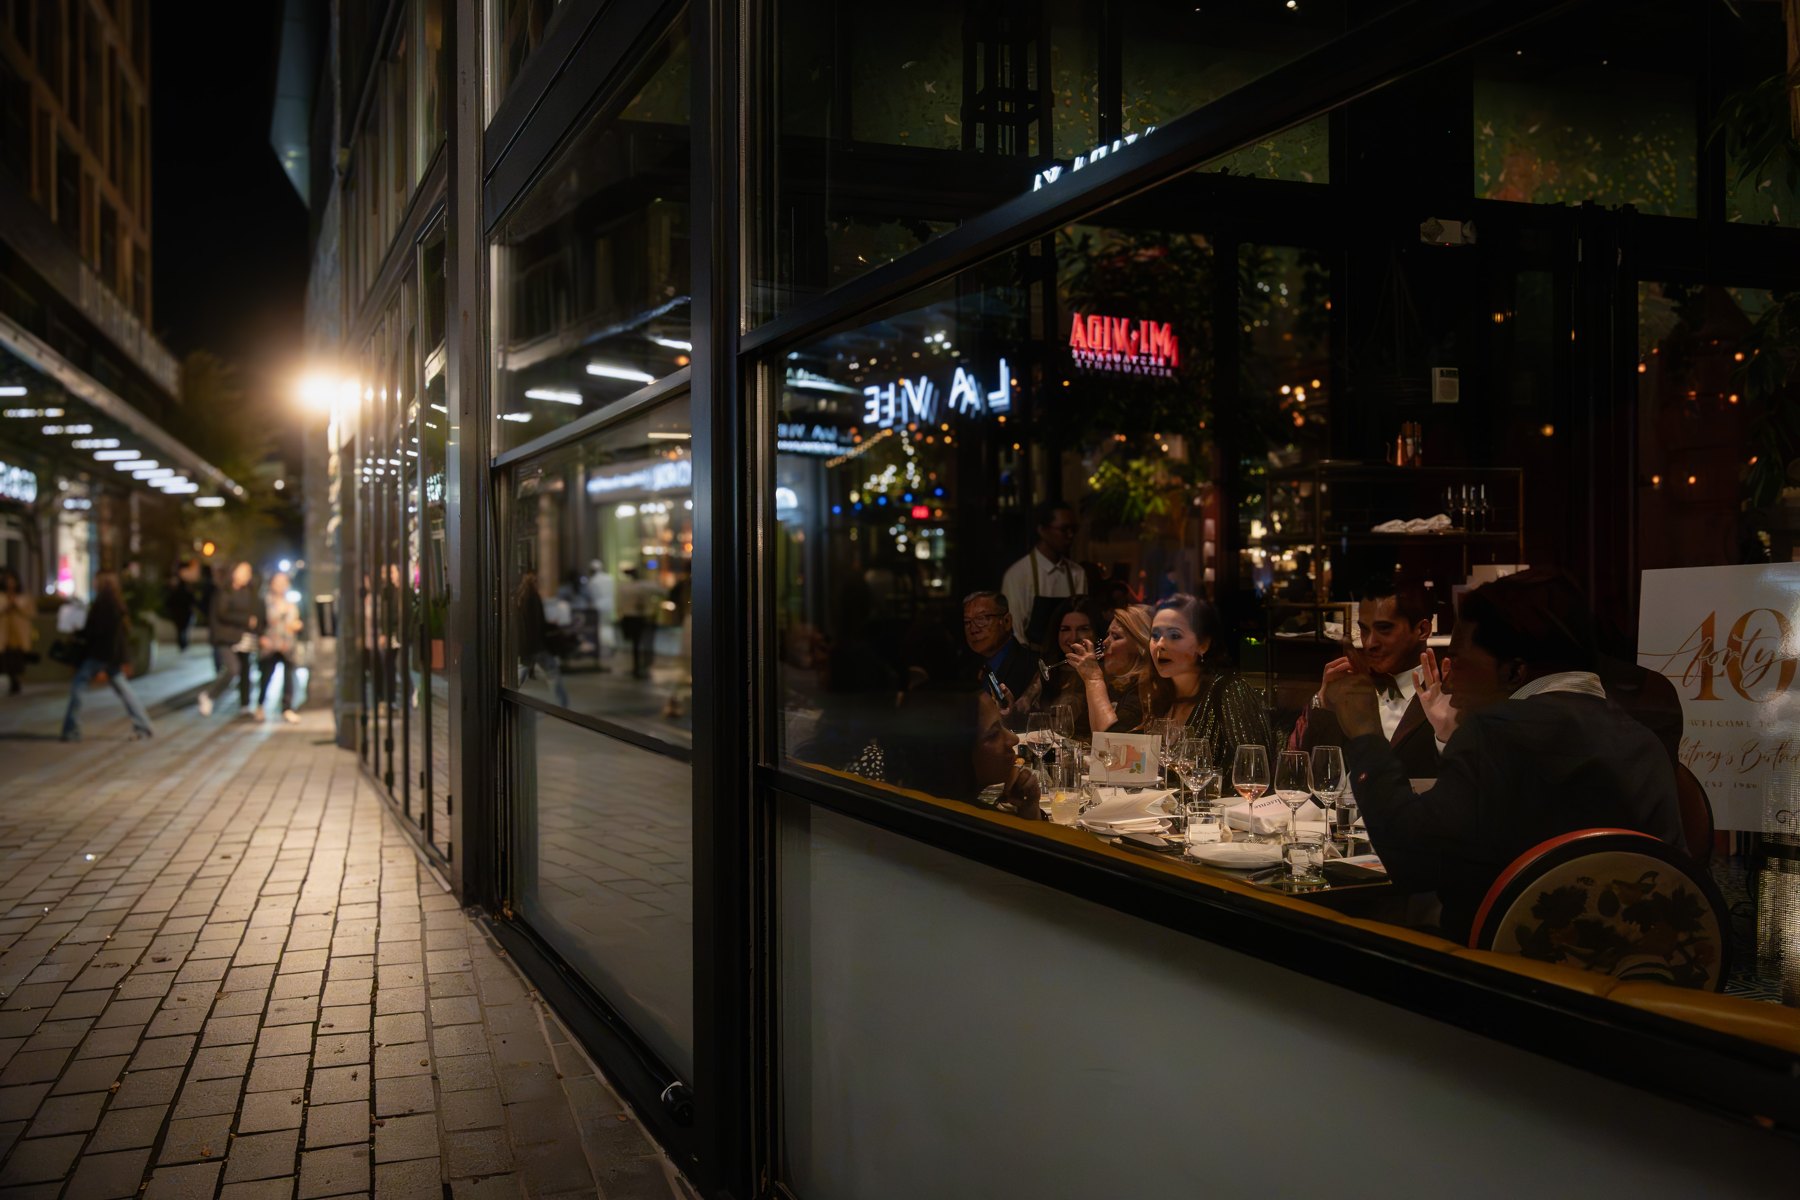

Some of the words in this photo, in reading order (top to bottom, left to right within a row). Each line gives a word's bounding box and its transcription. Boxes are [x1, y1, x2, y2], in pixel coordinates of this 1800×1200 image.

[1637, 628, 1795, 689] forty
[1659, 608, 1797, 703] 40
[1688, 719, 1752, 729] WELCOME
